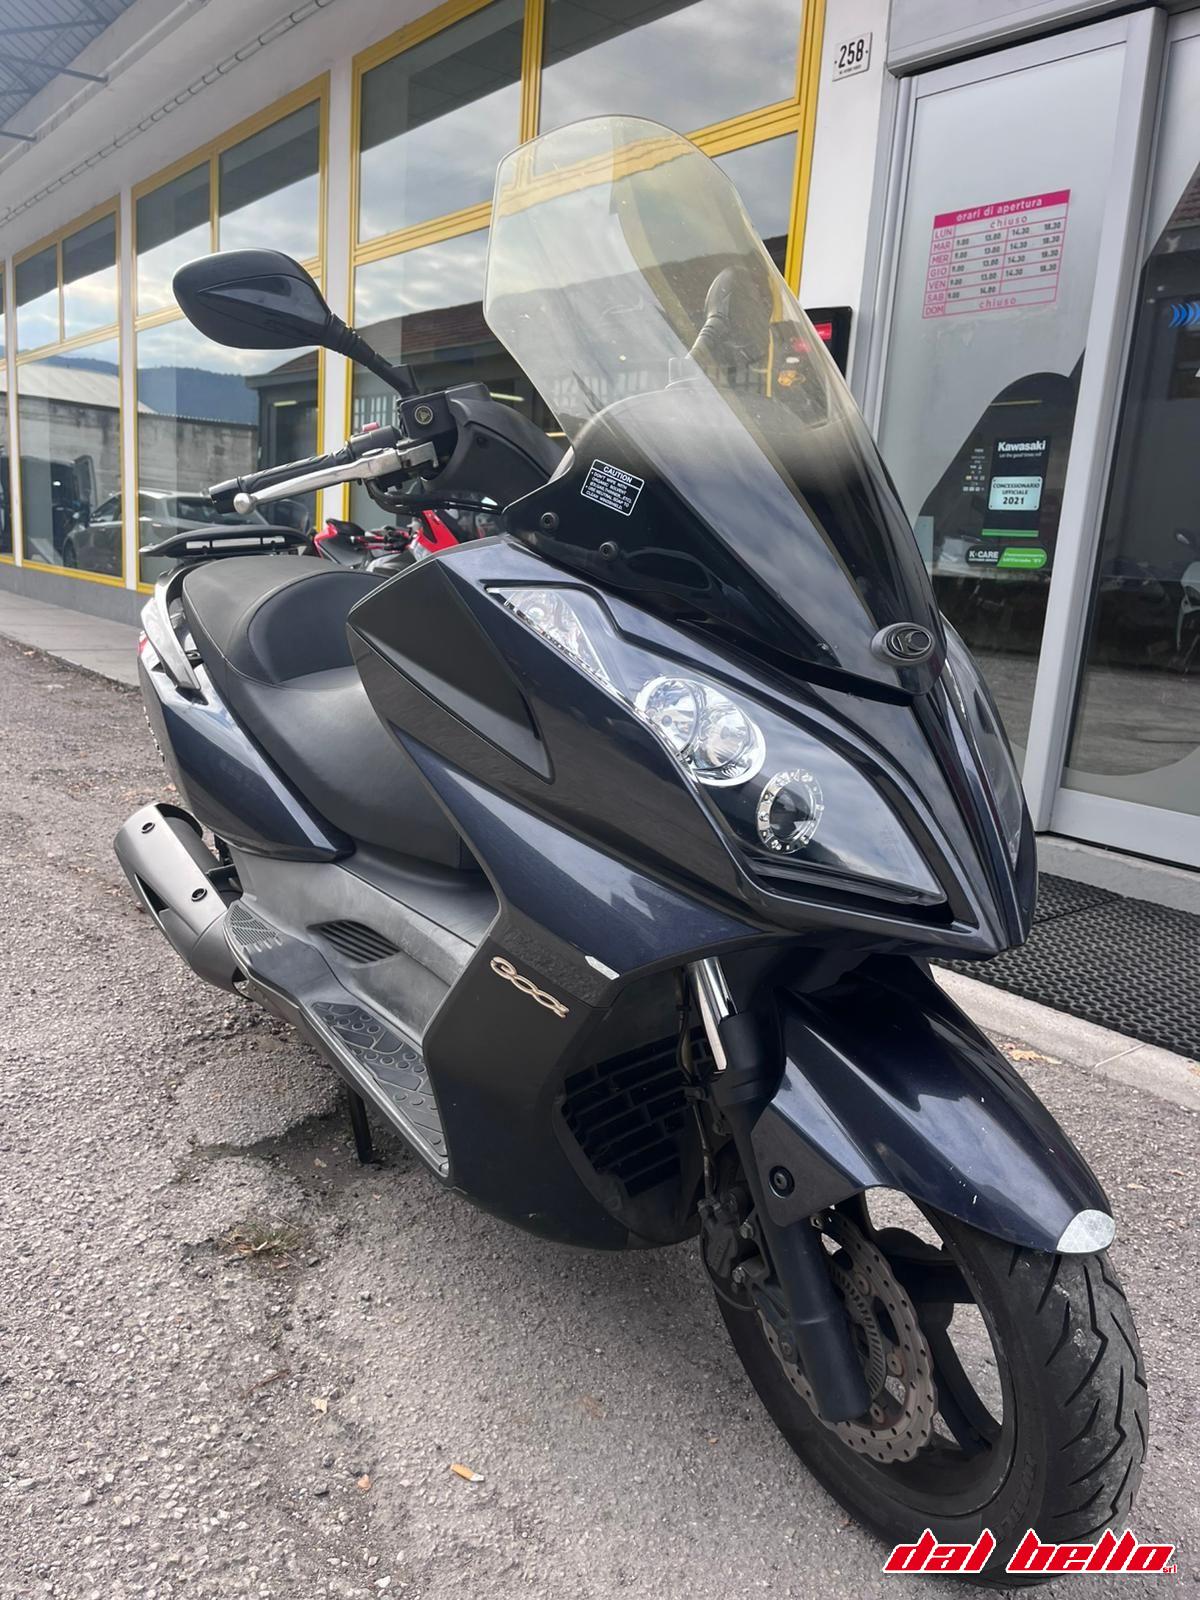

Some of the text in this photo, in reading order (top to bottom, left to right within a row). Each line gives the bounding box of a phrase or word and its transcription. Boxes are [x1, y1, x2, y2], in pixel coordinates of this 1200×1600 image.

[838, 38, 864, 69] 258
[956, 199, 1042, 222] orari di apertura
[935, 216, 1028, 239] LUN chiuso
[933, 240, 951, 251] MAR
[1012, 227, 1030, 236] 14.30
[932, 254, 949, 264] MER
[1010, 241, 1027, 250] 14.30
[930, 267, 947, 277] GIO
[1007, 255, 1025, 264] 14.30
[928, 280, 945, 290] VEN
[1005, 268, 1023, 277] 14.30
[925, 297, 1017, 315] DOM chiuso
[927, 292, 944, 302] SAB
[998, 440, 1046, 452] Kawasaki
[603, 466, 632, 483] CAUTION
[1003, 497, 1024, 505] 2021
